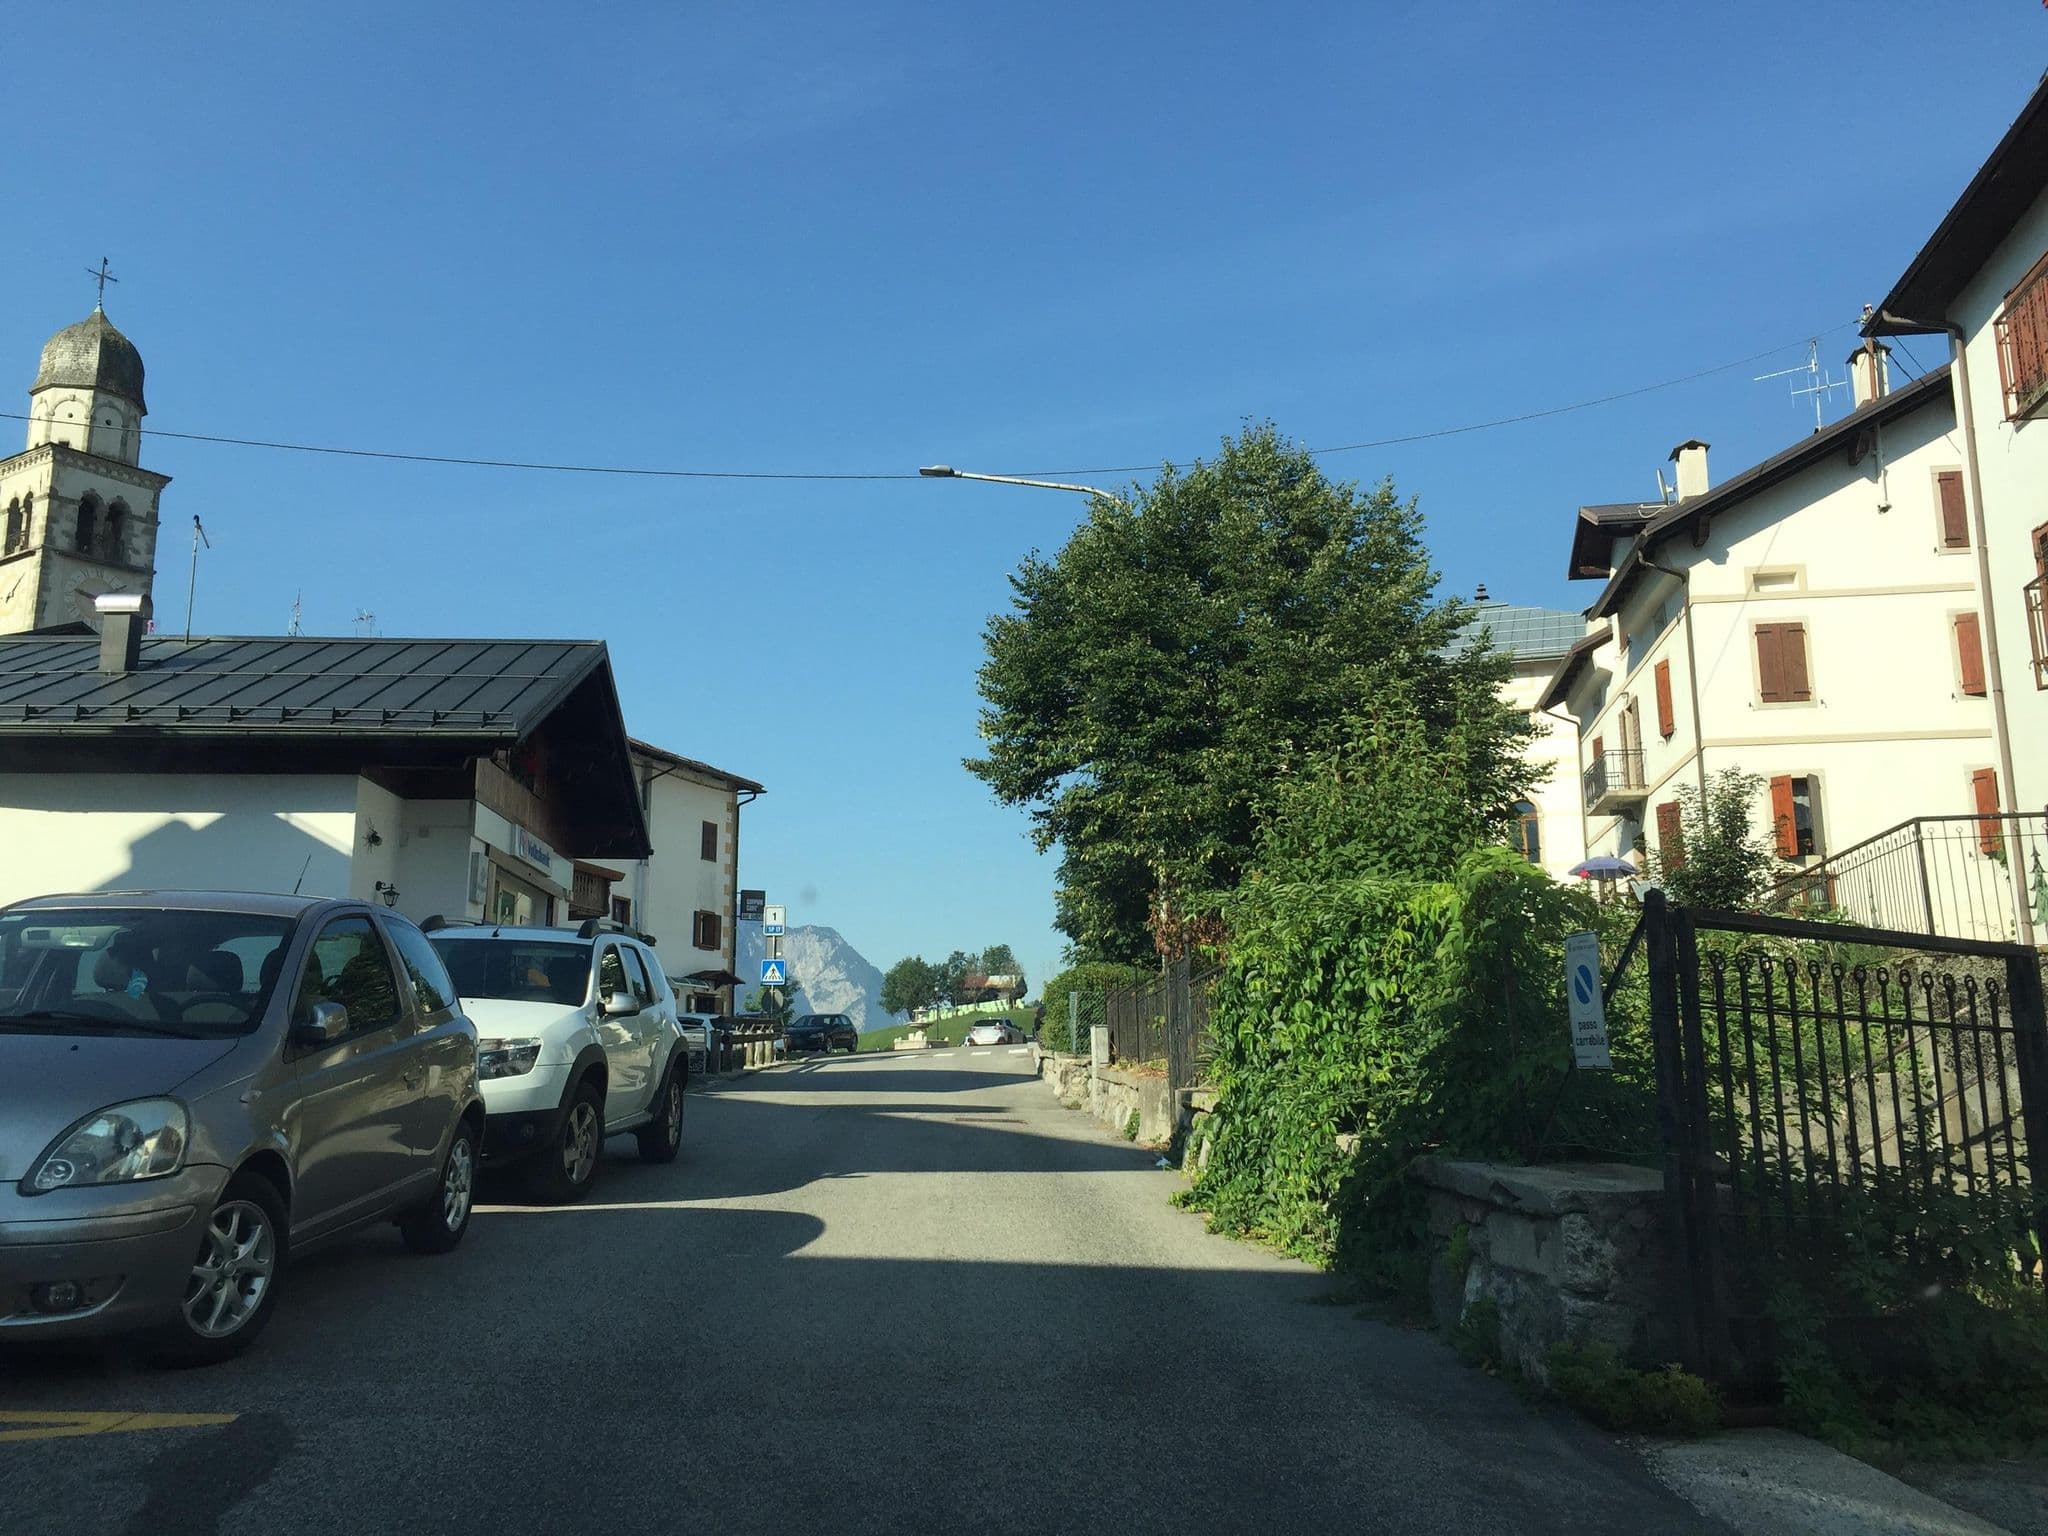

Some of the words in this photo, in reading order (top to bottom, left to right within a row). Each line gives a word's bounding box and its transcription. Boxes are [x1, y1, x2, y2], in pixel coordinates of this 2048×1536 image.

[773, 912, 777, 921] 1
[1578, 1021, 1597, 1032] passo
[1576, 1035, 1605, 1046] carrabile
